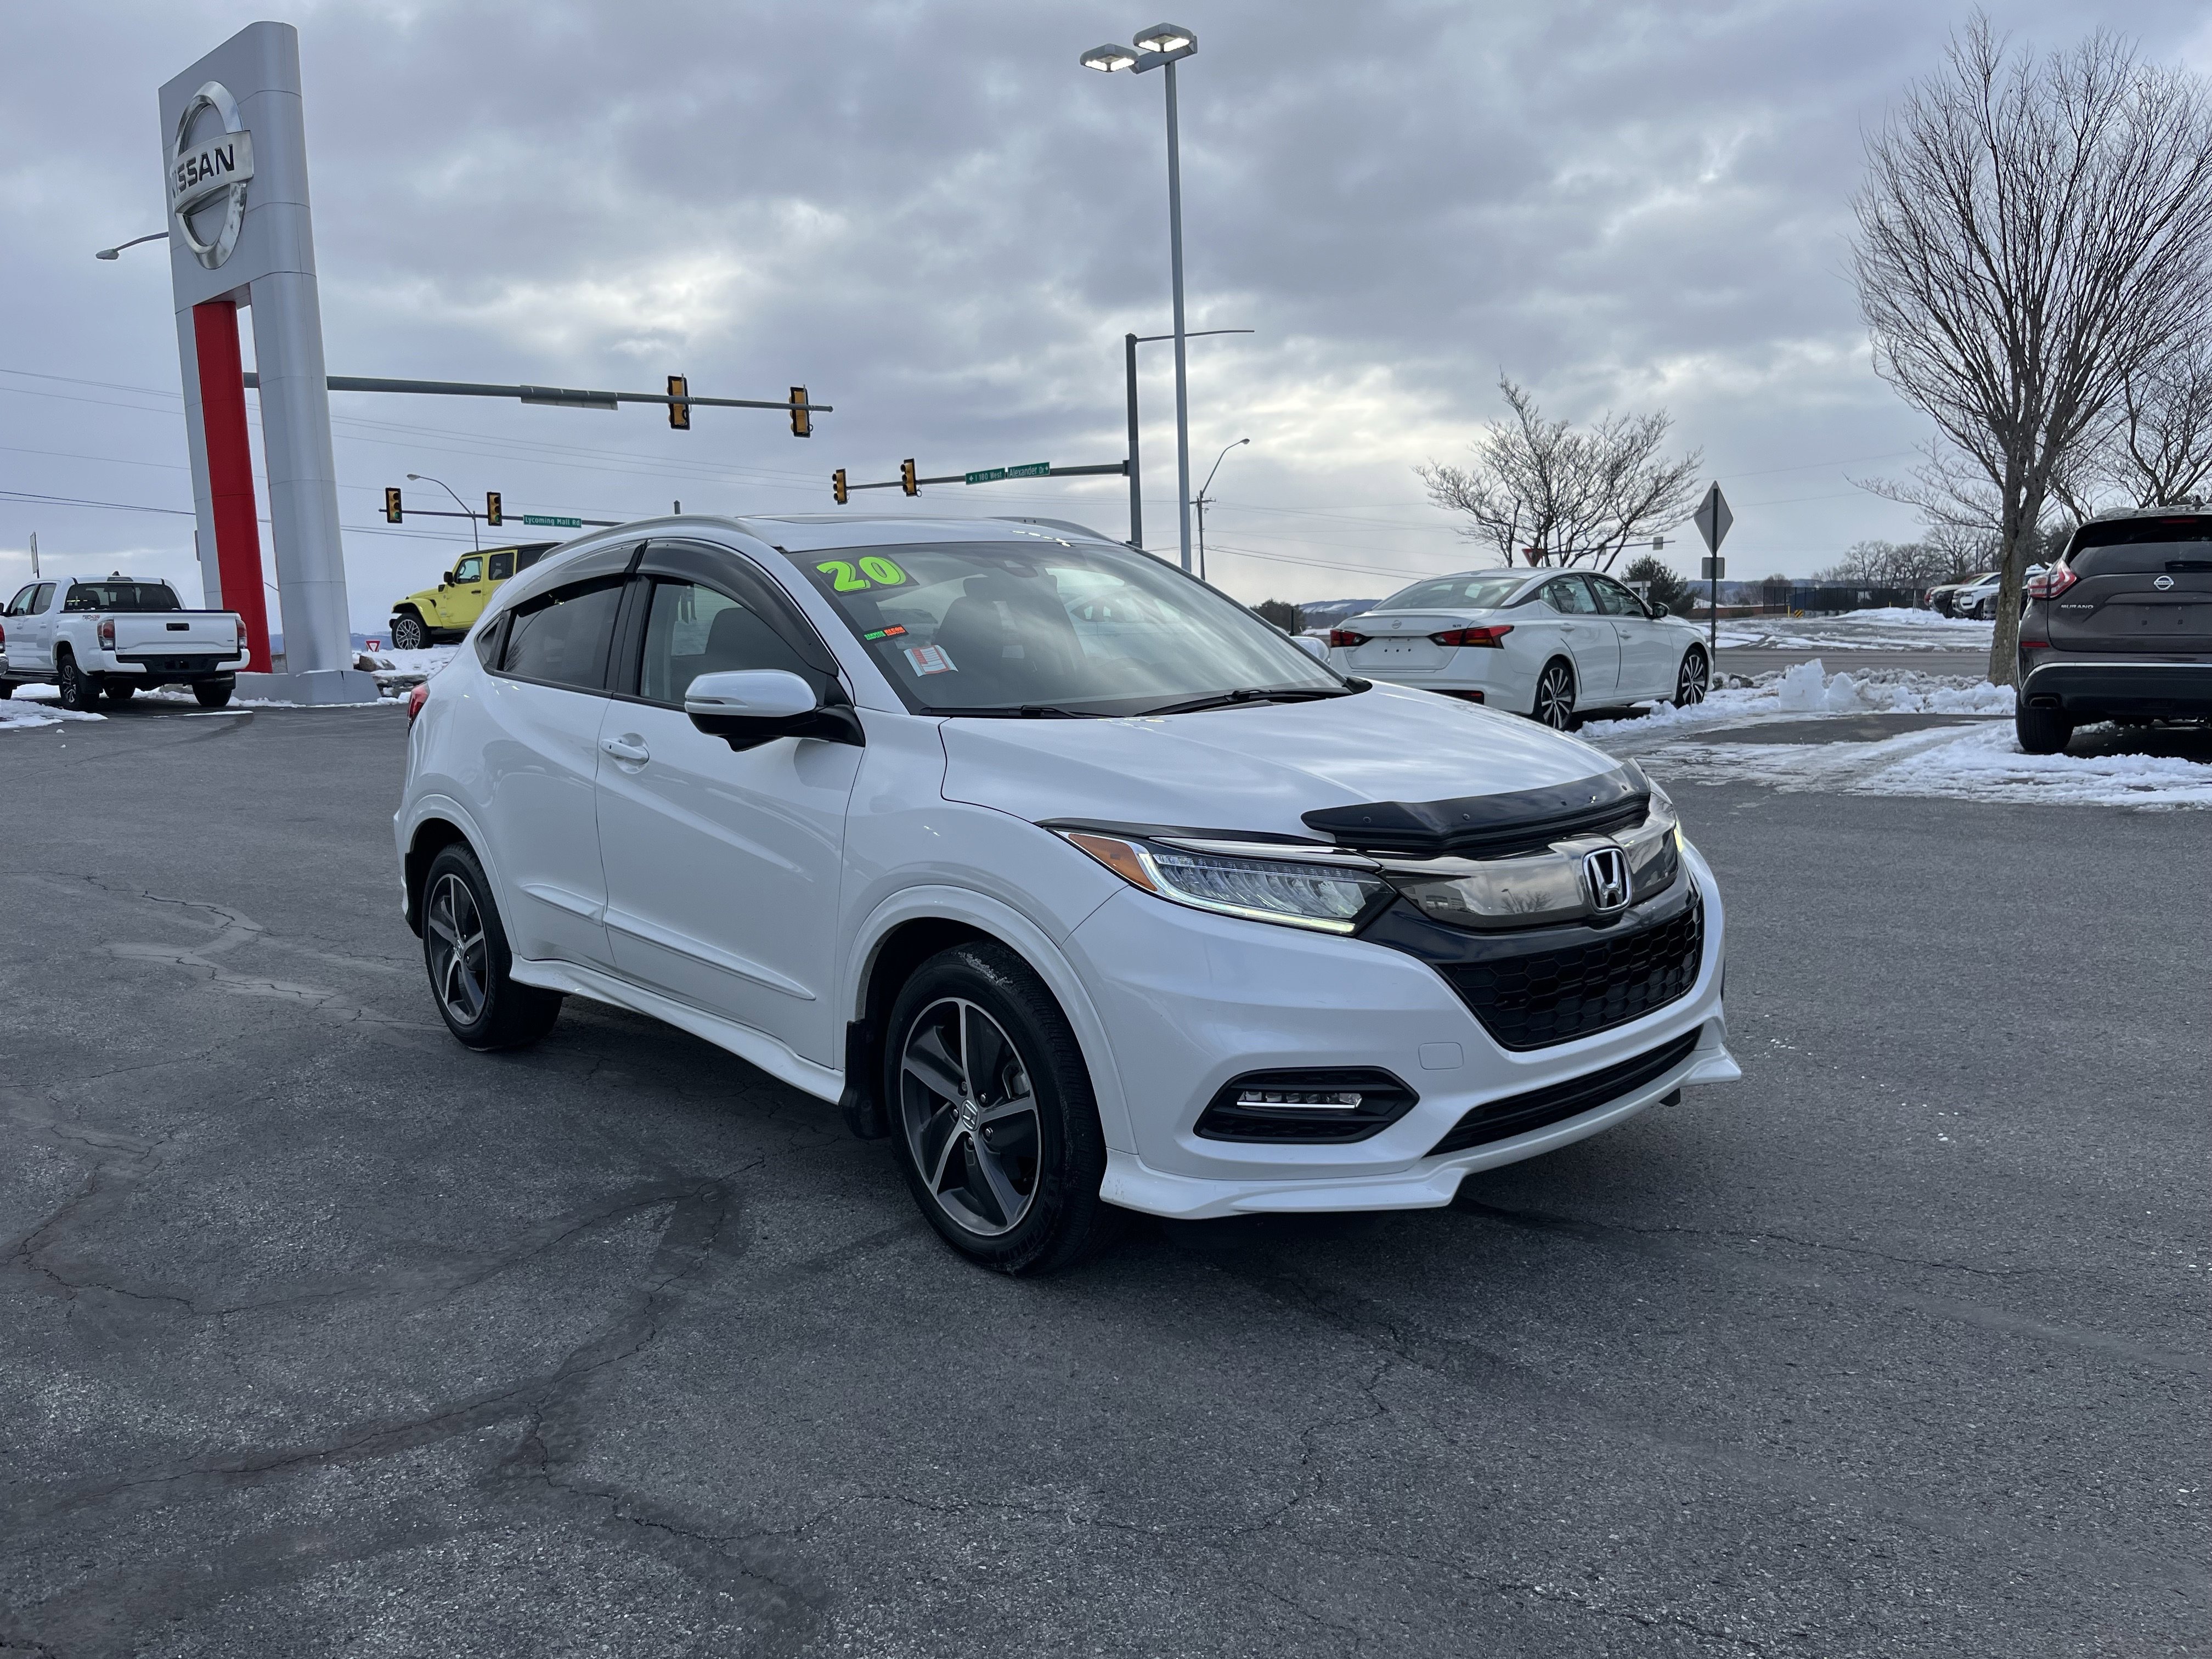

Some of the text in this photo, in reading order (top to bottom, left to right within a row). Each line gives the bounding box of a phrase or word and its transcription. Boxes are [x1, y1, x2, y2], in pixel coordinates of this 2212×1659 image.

[979, 472, 989, 481] 180
[1009, 466, 1045, 478] Alexander Dr
[525, 516, 555, 526] Lycoming
[816, 556, 906, 592] 20
